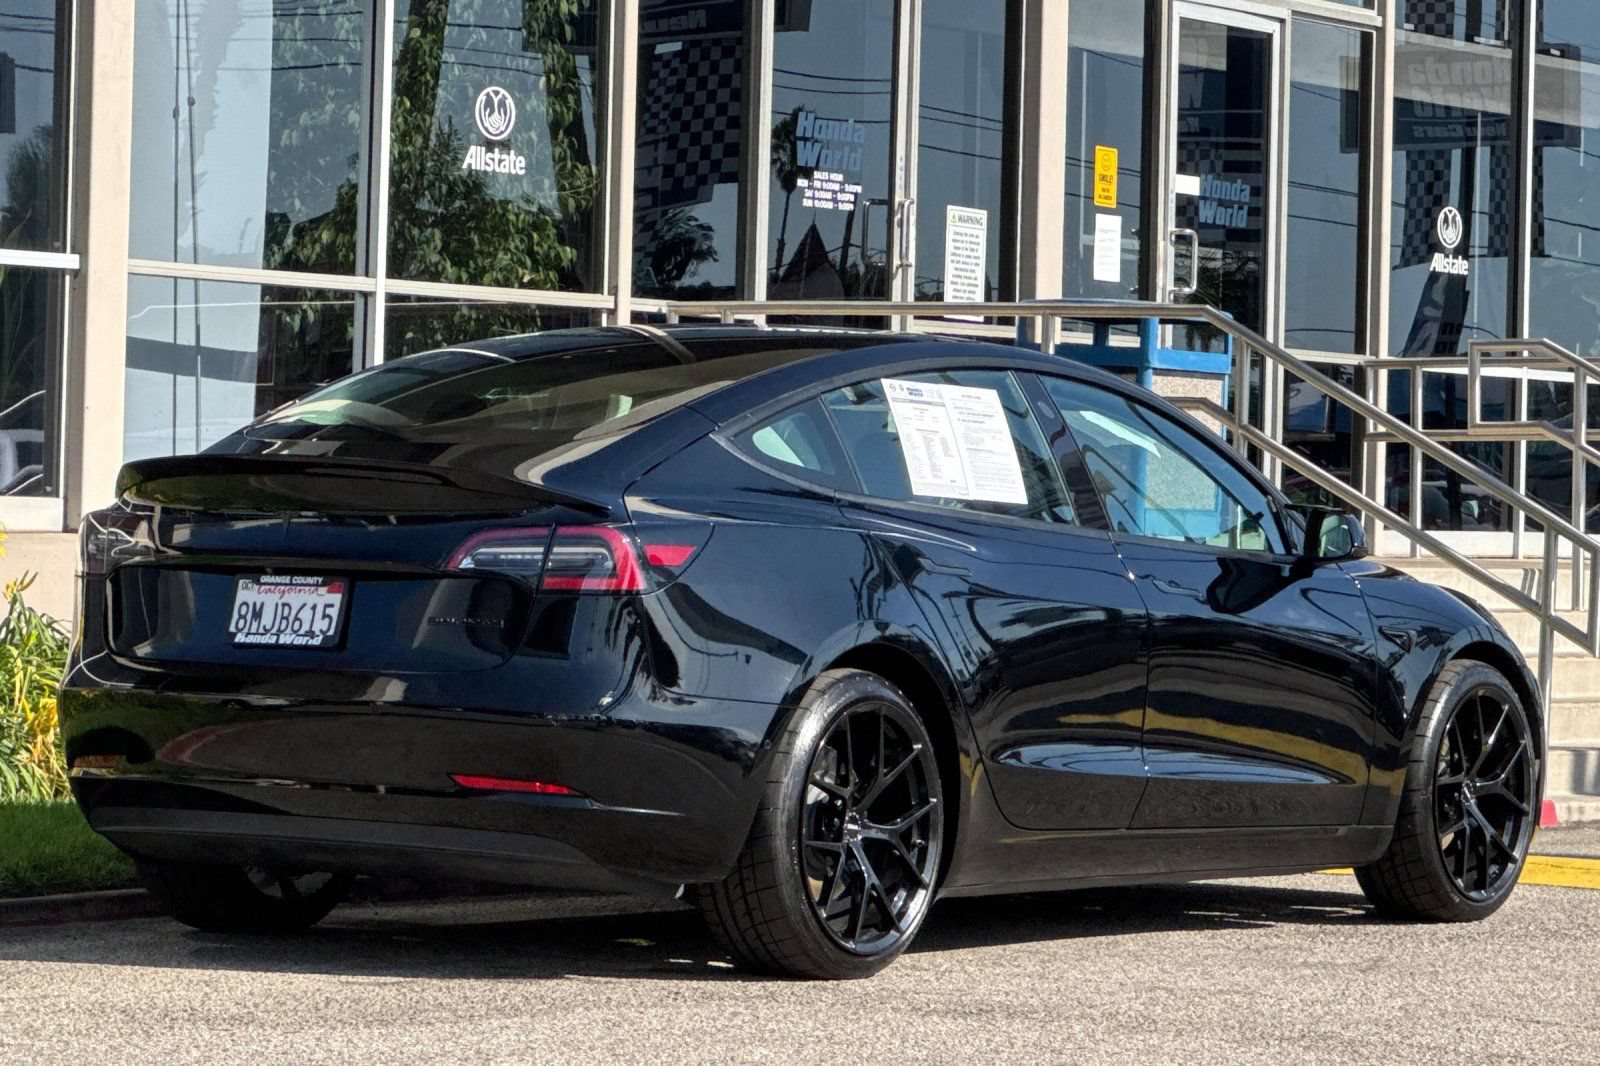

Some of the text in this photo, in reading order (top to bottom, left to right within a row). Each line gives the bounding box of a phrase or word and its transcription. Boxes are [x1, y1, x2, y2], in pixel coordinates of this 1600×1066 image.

[796, 111, 866, 144] Honda
[462, 145, 526, 175] Allstate
[796, 141, 863, 172] World
[1200, 173, 1251, 202] Honda
[957, 214, 983, 227] WARNING
[1199, 200, 1248, 228] World
[1429, 252, 1469, 275] Allstate
[257, 584, 320, 600] California
[260, 575, 323, 585] ORANGE COUNTY
[235, 601, 335, 636] 8MJB615
[234, 632, 278, 644] Honda
